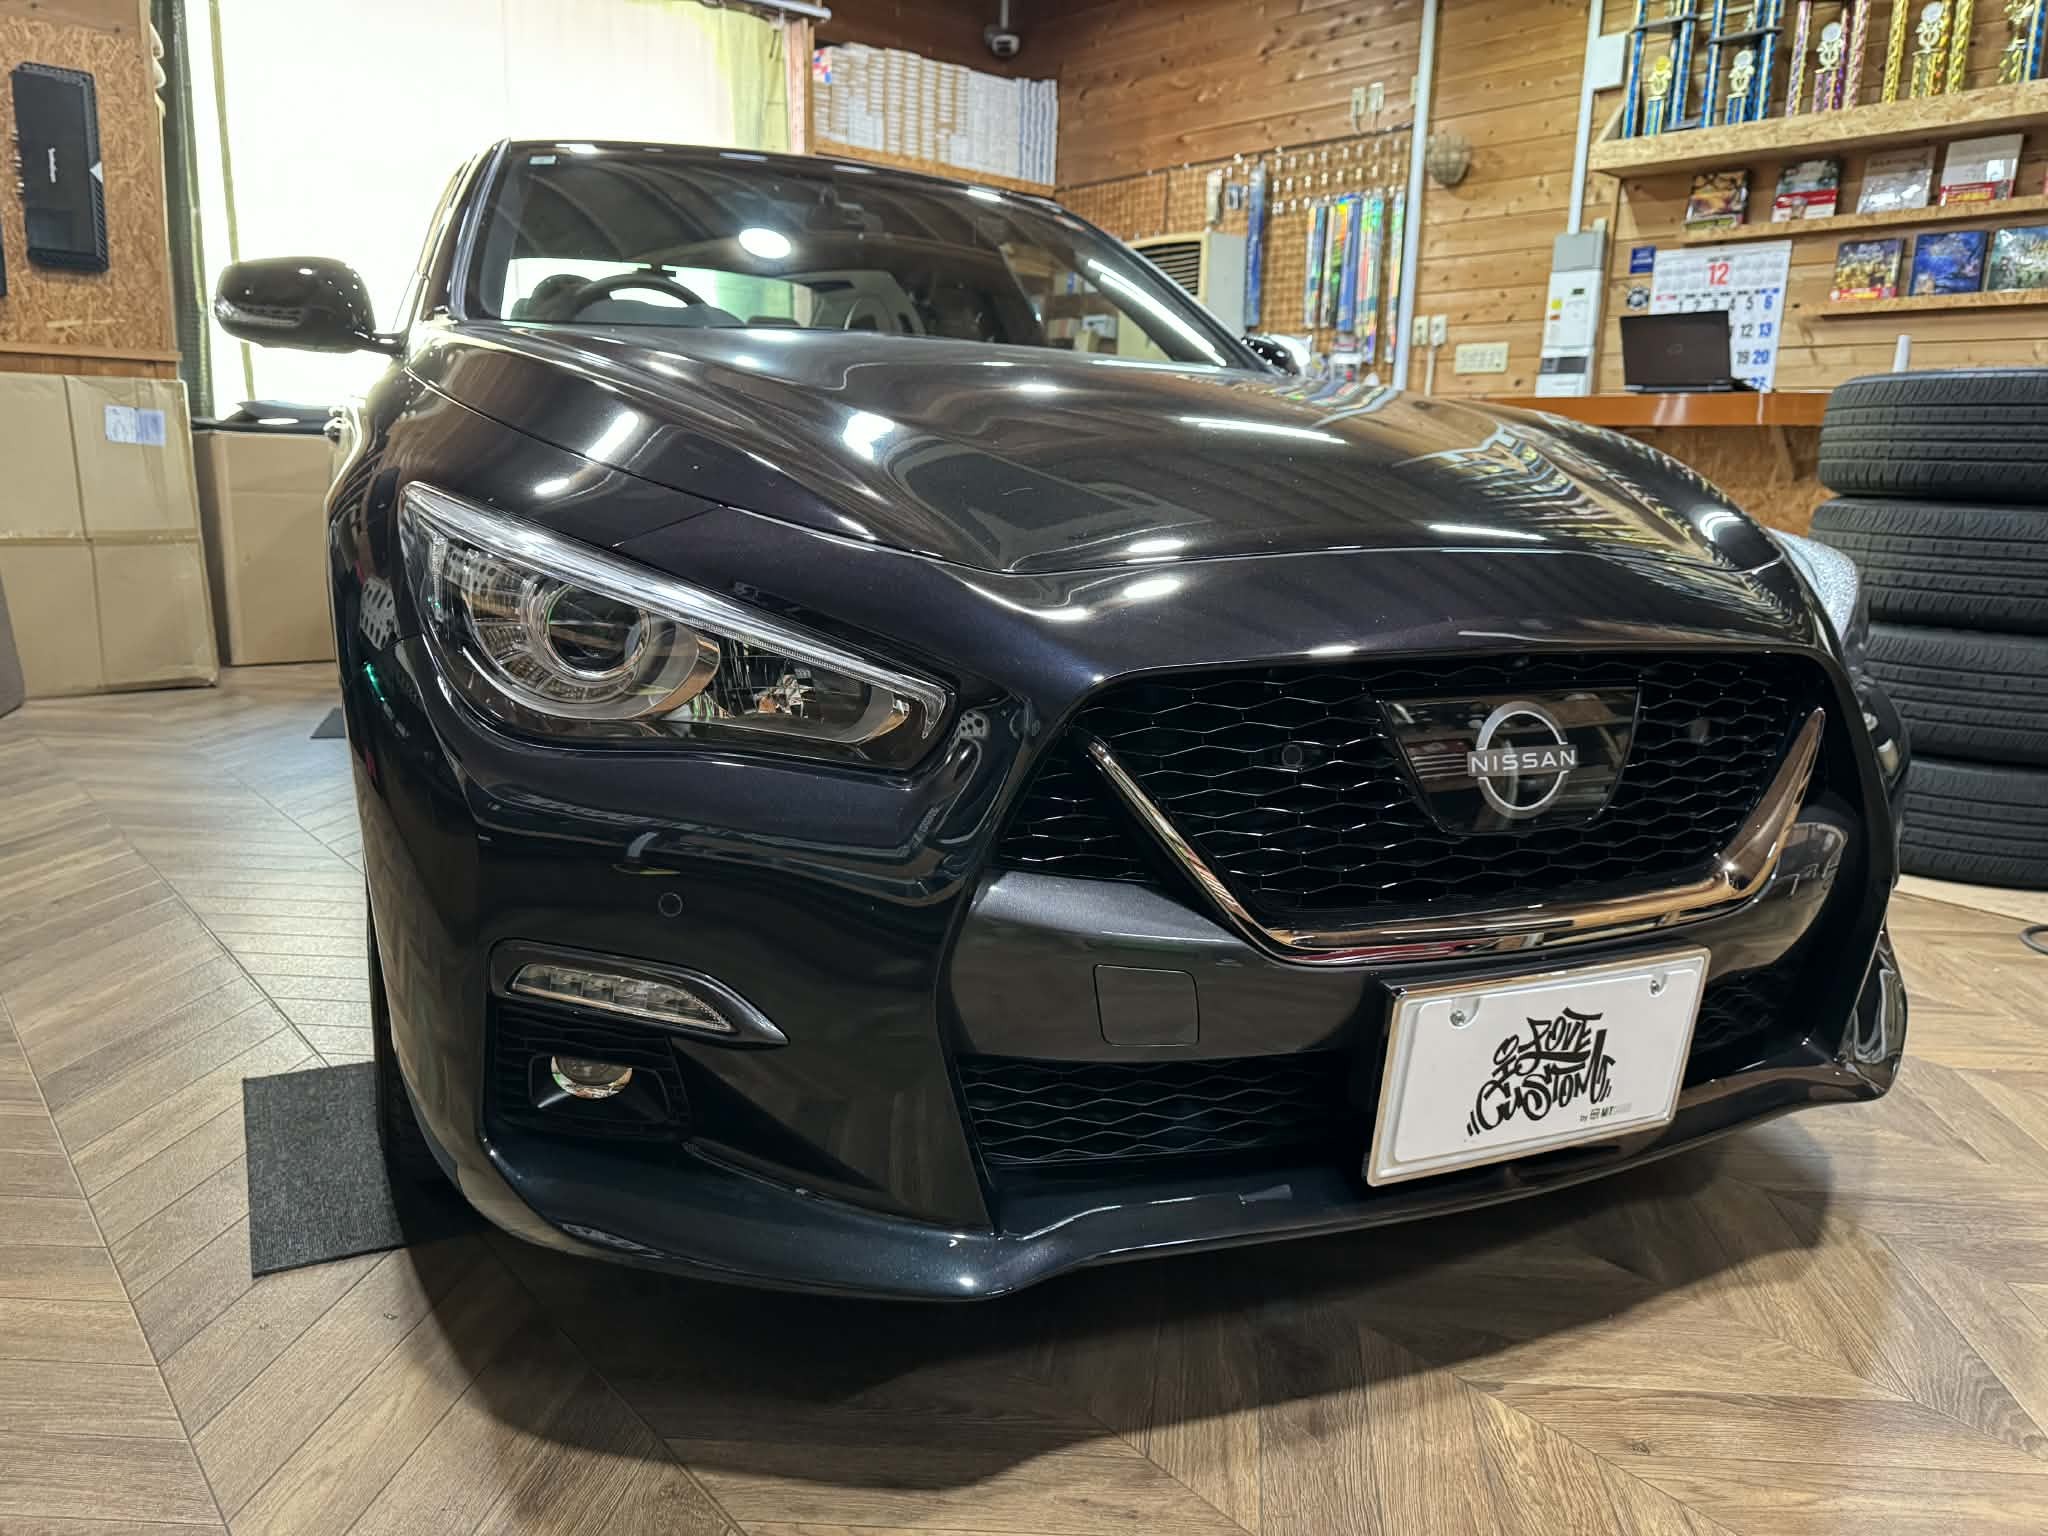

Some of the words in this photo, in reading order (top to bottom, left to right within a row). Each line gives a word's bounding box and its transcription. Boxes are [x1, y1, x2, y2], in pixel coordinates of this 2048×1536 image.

[1708, 262, 1730, 286] 12
[1759, 322, 1772, 337] 13
[1752, 349, 1769, 364] 20
[1471, 749, 1577, 774] NISSAN
